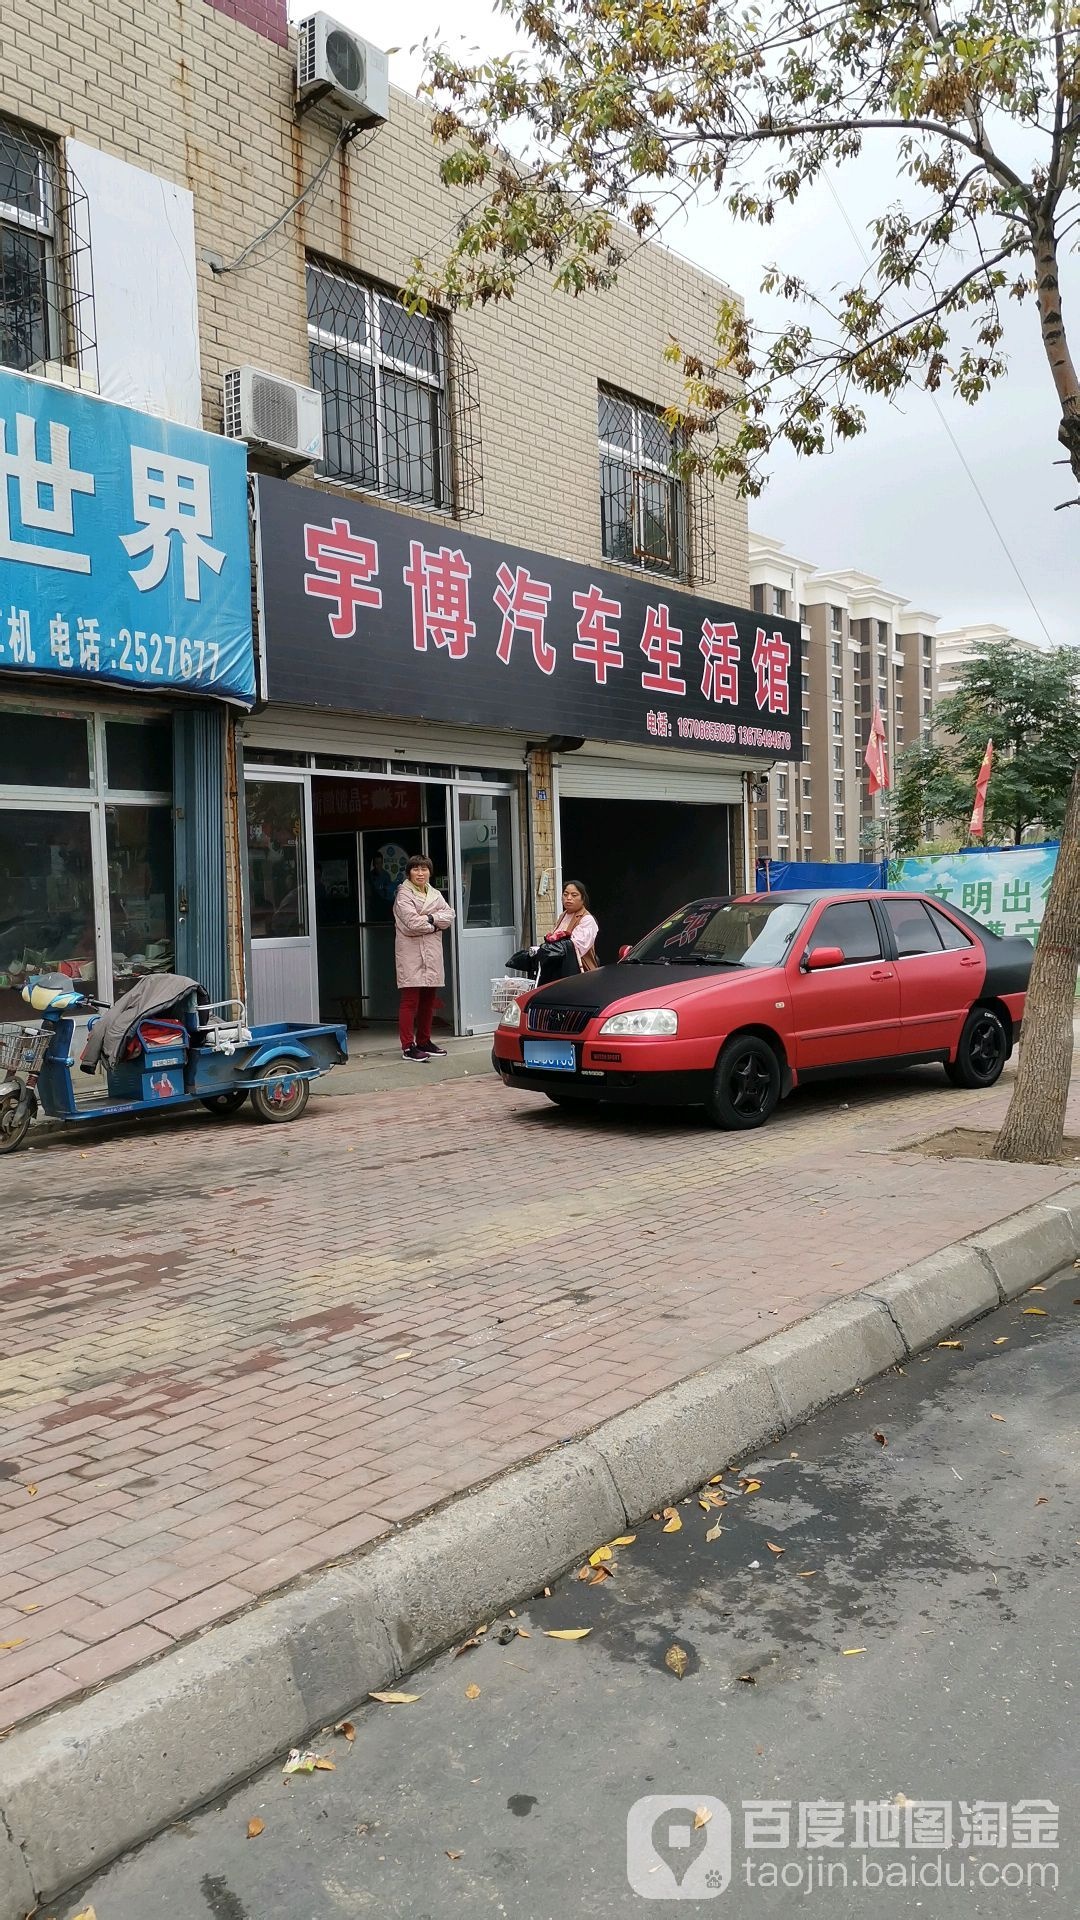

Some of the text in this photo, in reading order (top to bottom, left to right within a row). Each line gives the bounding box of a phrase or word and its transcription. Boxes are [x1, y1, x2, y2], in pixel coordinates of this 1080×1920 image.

[0, 412, 227, 601] 世界
[0, 605, 36, 664] 机
[303, 517, 791, 716] 宇博汽车生活馆
